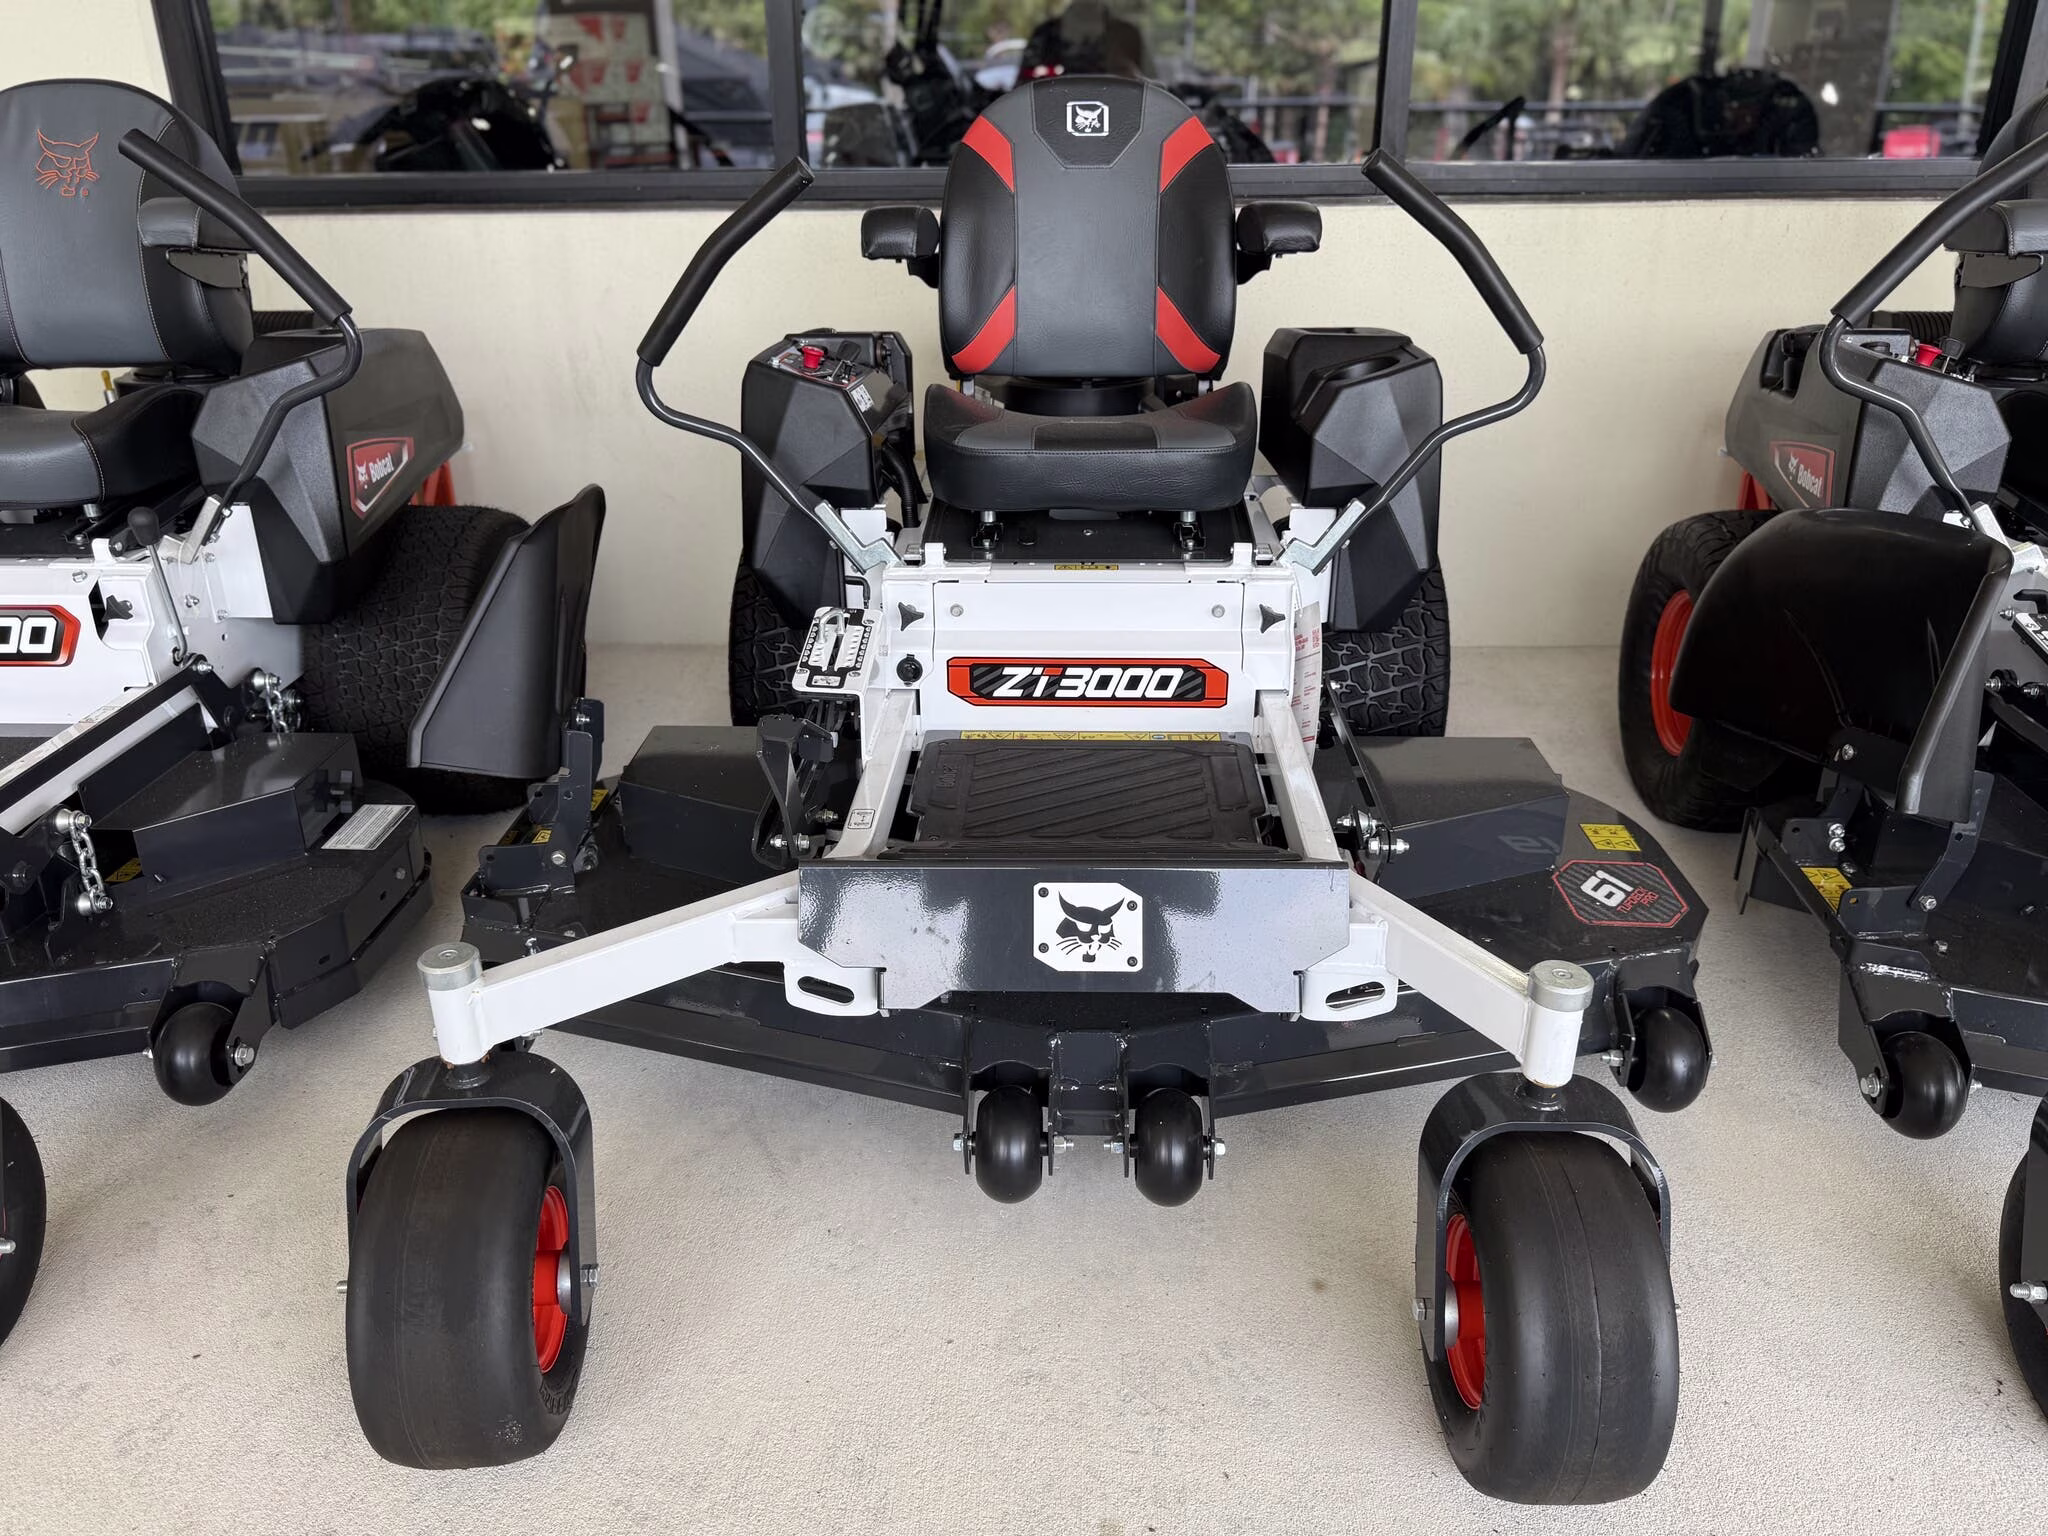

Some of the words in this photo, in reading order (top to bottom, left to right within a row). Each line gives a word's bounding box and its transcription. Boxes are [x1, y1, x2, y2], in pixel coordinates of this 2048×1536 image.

[368, 452, 395, 483] Bobcat
[1797, 464, 1822, 497] Bobcat
[992, 666, 1184, 699] ZT3000
[1580, 869, 1634, 907] 61
